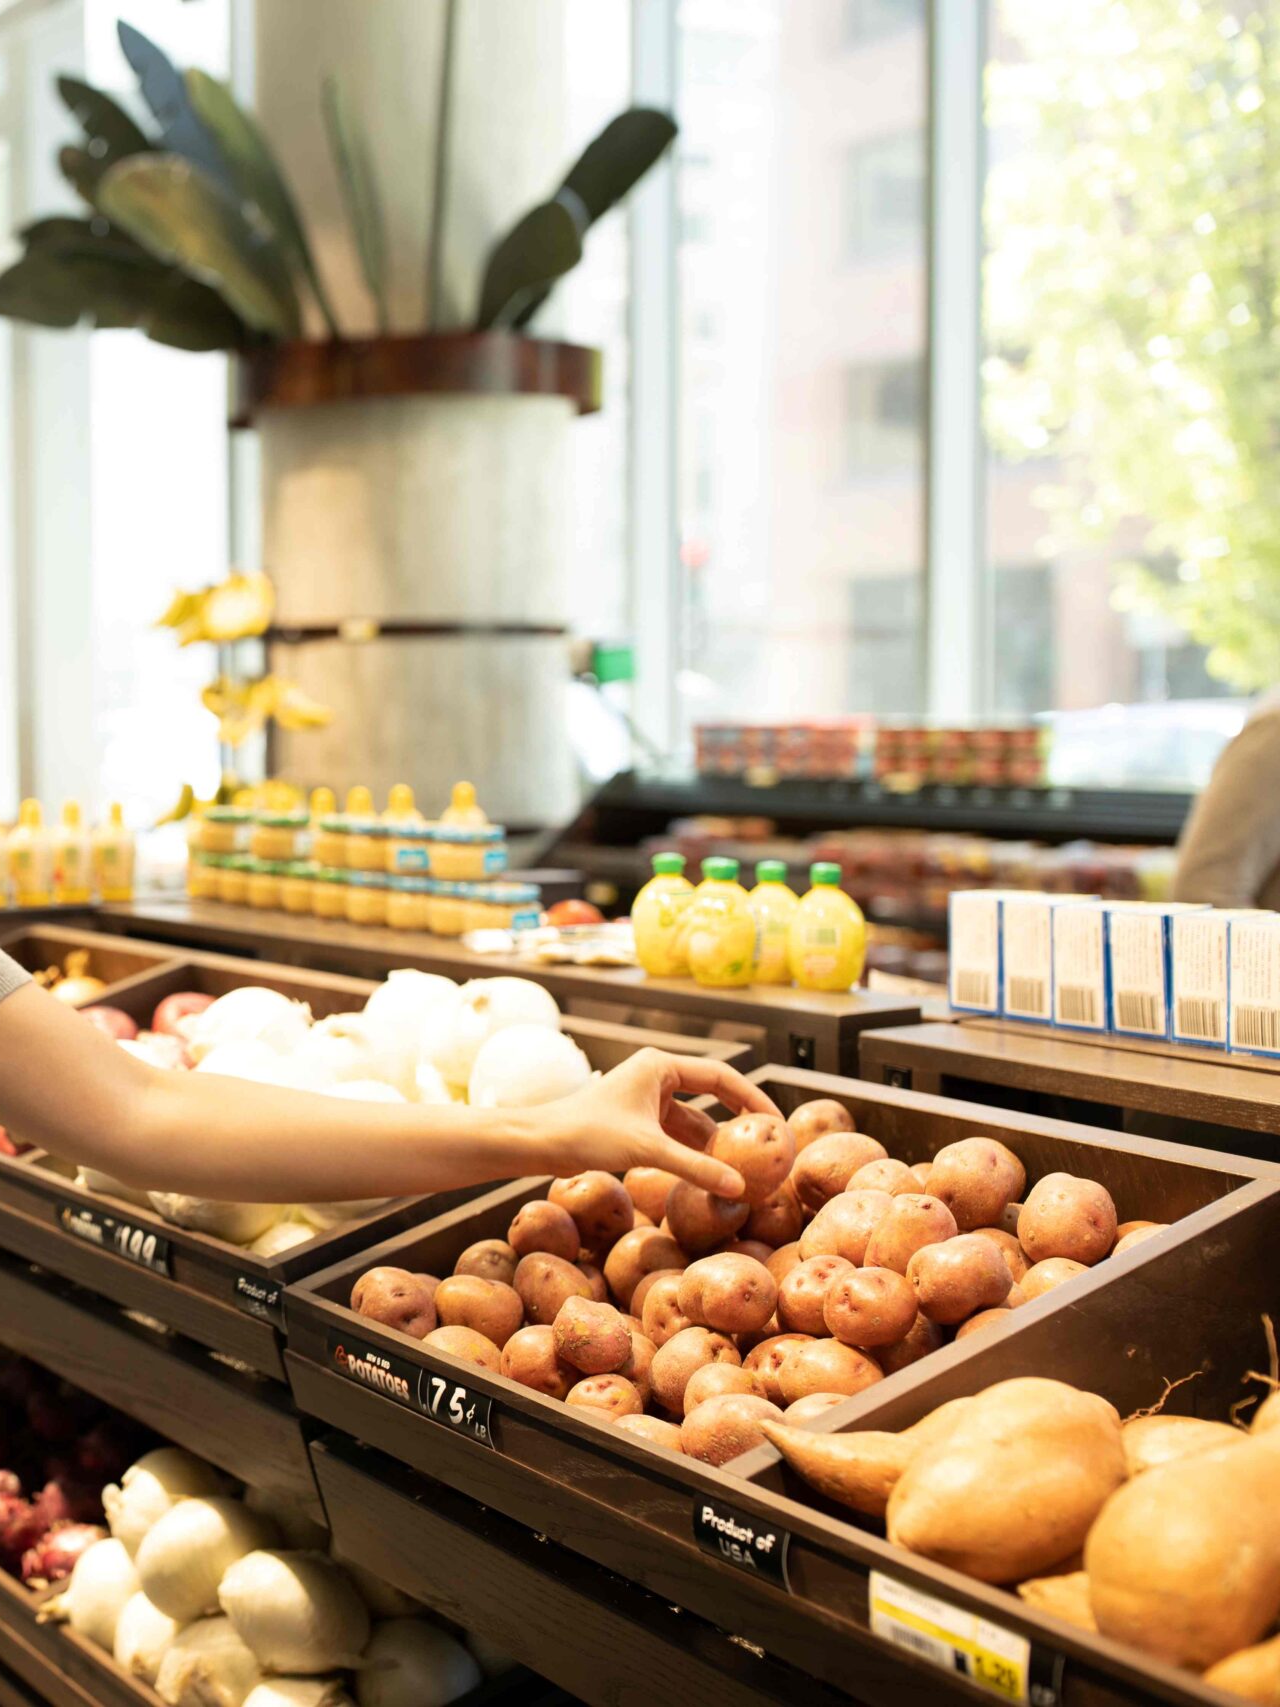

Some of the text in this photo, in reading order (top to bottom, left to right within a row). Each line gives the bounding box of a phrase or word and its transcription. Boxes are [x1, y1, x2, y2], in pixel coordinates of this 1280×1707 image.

[347, 1354, 410, 1401] POTATOES
[474, 1421, 487, 1439] LB
[701, 1505, 776, 1553] Product of
[718, 1537, 757, 1569] USA
